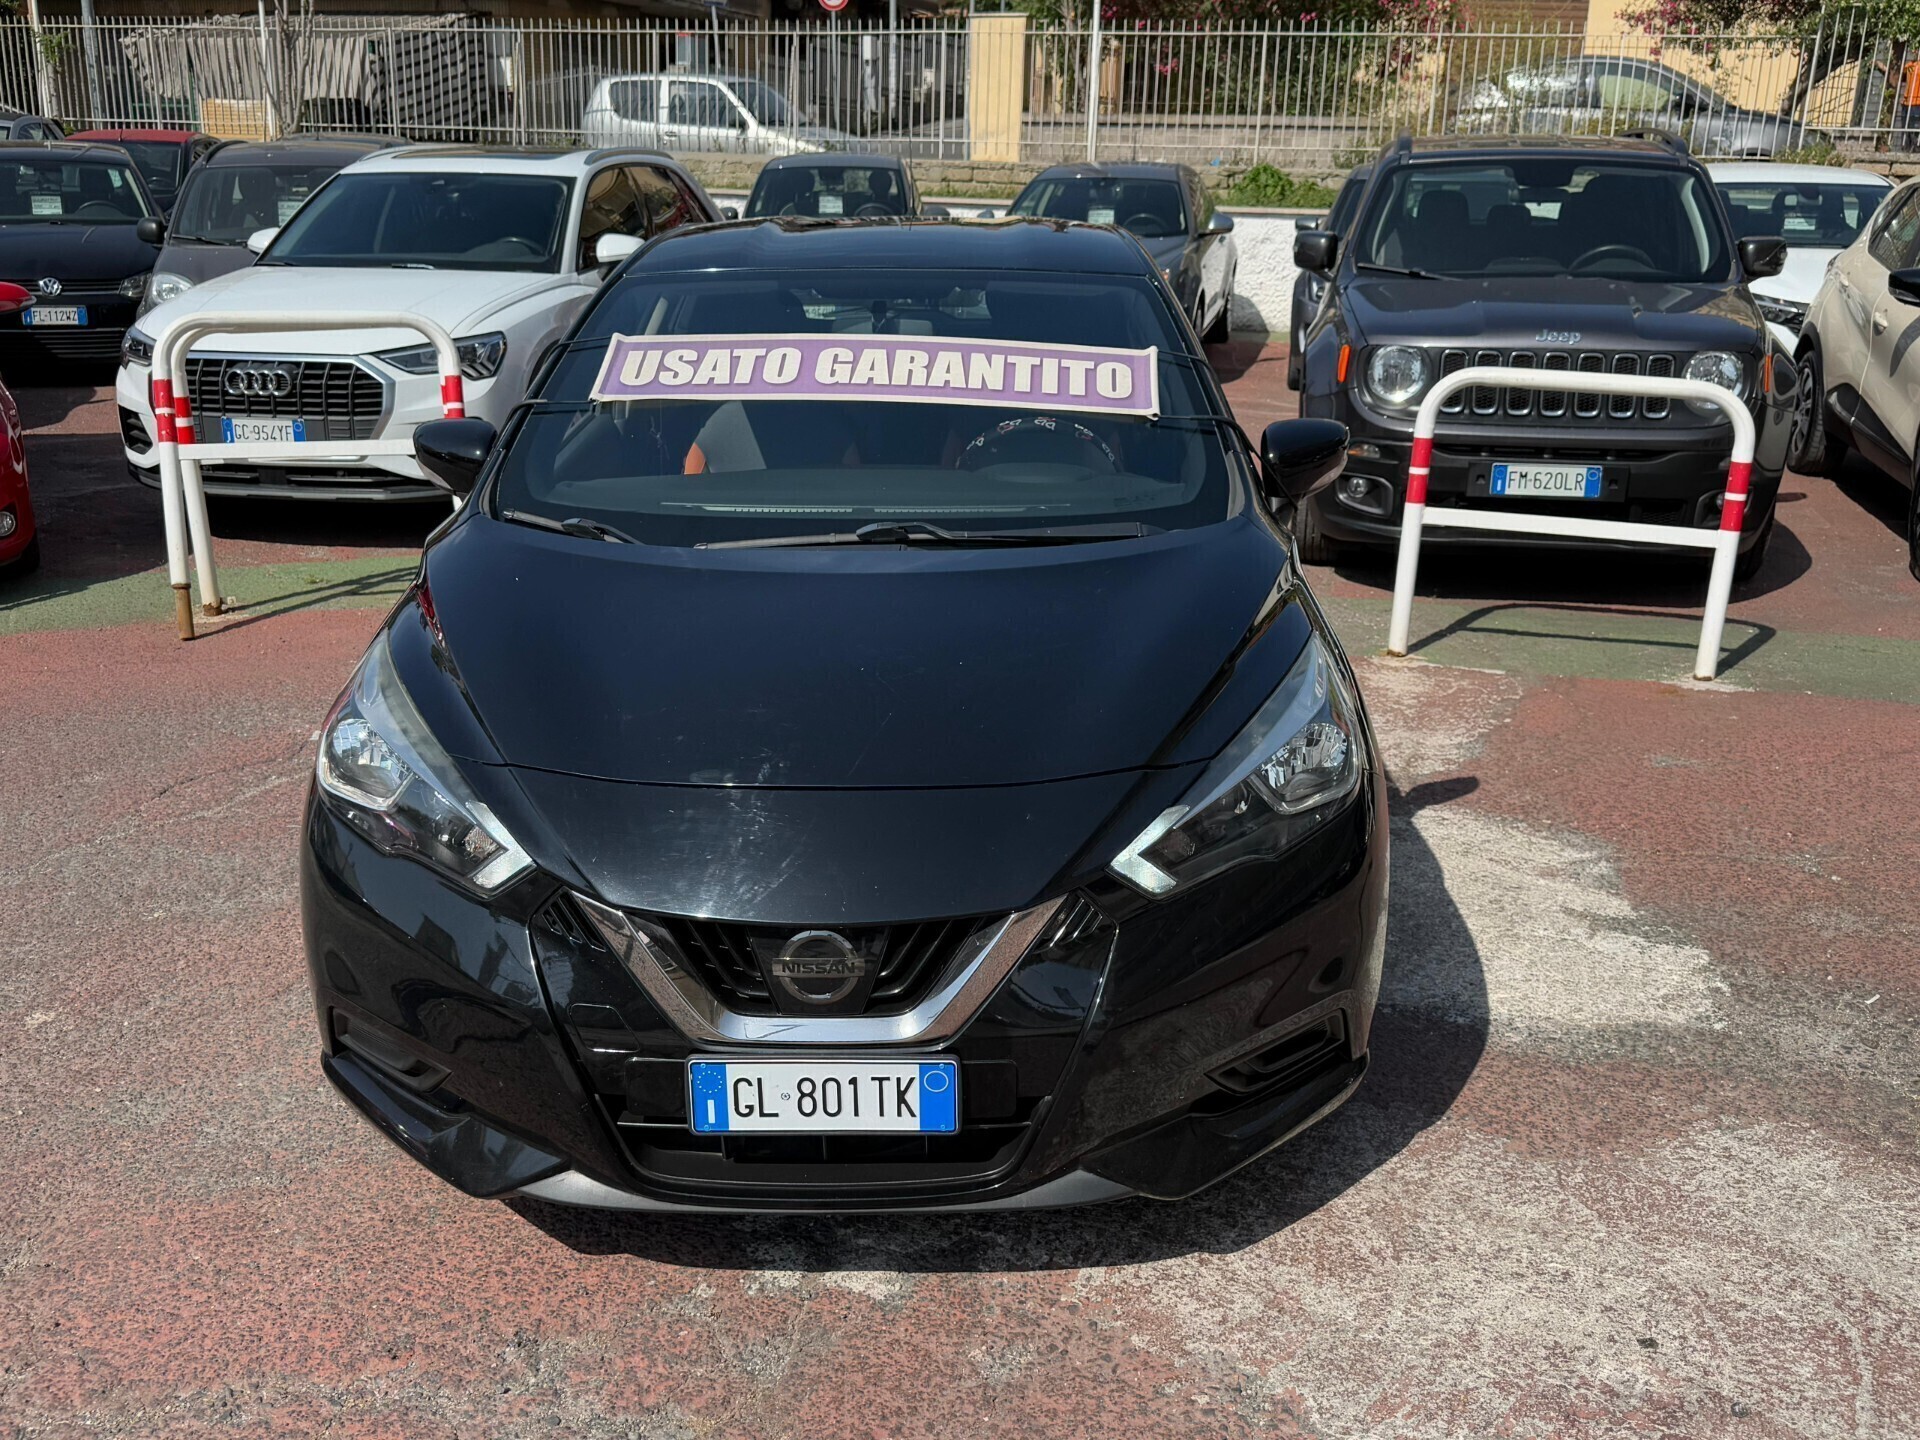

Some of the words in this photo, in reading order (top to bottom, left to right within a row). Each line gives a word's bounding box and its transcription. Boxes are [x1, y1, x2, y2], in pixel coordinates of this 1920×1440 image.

[1535, 329, 1581, 345] Jeep
[619, 347, 802, 386] USATO
[814, 347, 1133, 400] GARANTITO
[781, 962, 856, 974] NISSAN
[732, 1077, 780, 1118] GL
